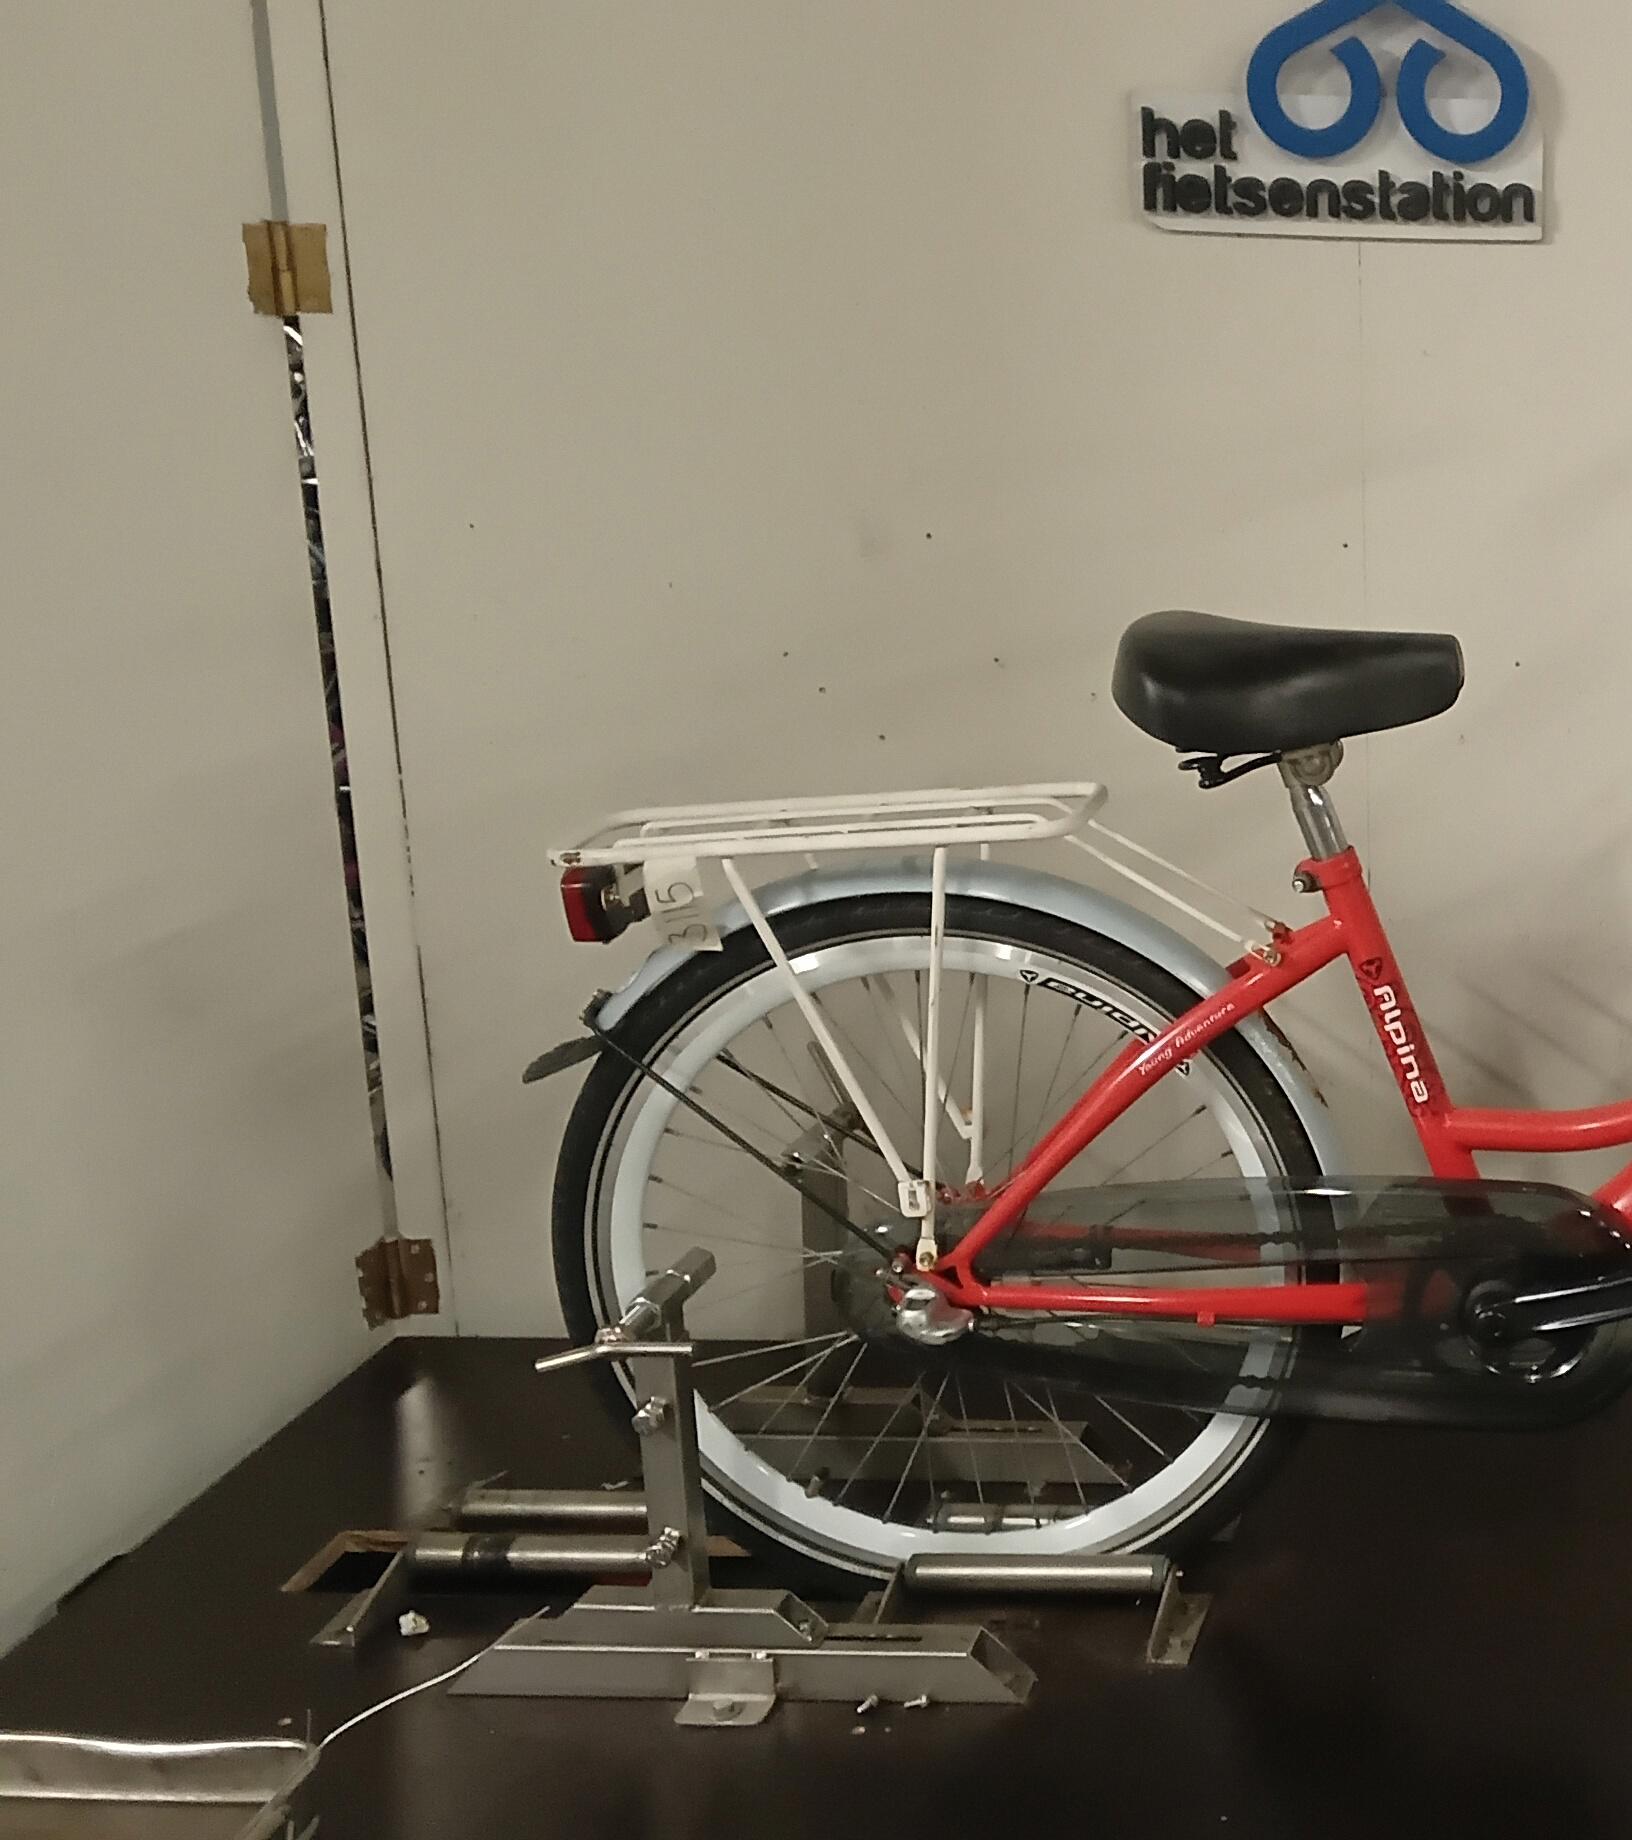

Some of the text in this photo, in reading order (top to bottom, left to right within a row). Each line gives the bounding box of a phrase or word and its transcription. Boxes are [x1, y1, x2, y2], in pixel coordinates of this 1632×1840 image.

[1141, 106, 1238, 161] het
[1142, 161, 1535, 223] fietsenstation
[1138, 1047, 1173, 1075] Young
[1373, 985, 1428, 1103] Alpina
